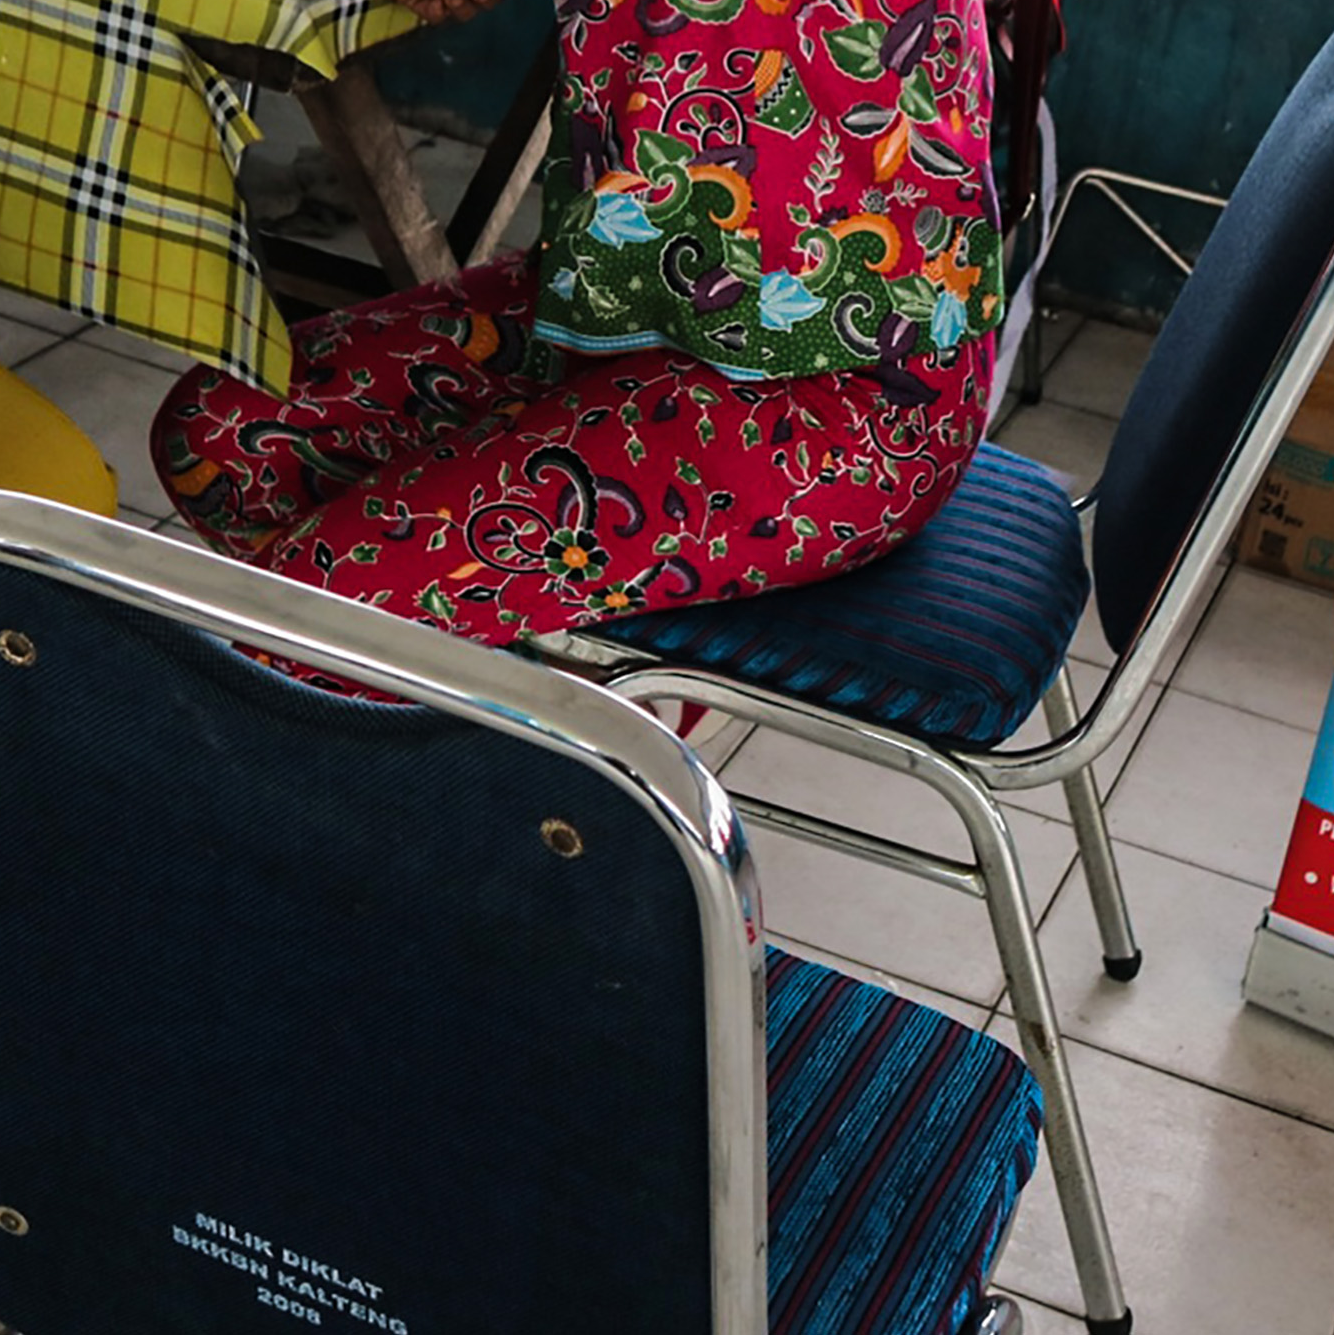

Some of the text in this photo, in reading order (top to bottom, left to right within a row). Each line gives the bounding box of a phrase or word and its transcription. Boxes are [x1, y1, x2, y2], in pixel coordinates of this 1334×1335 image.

[172, 1225, 407, 1335] BKKBN KALTENG
[195, 1212, 382, 1299] MILIK DIKLAT
